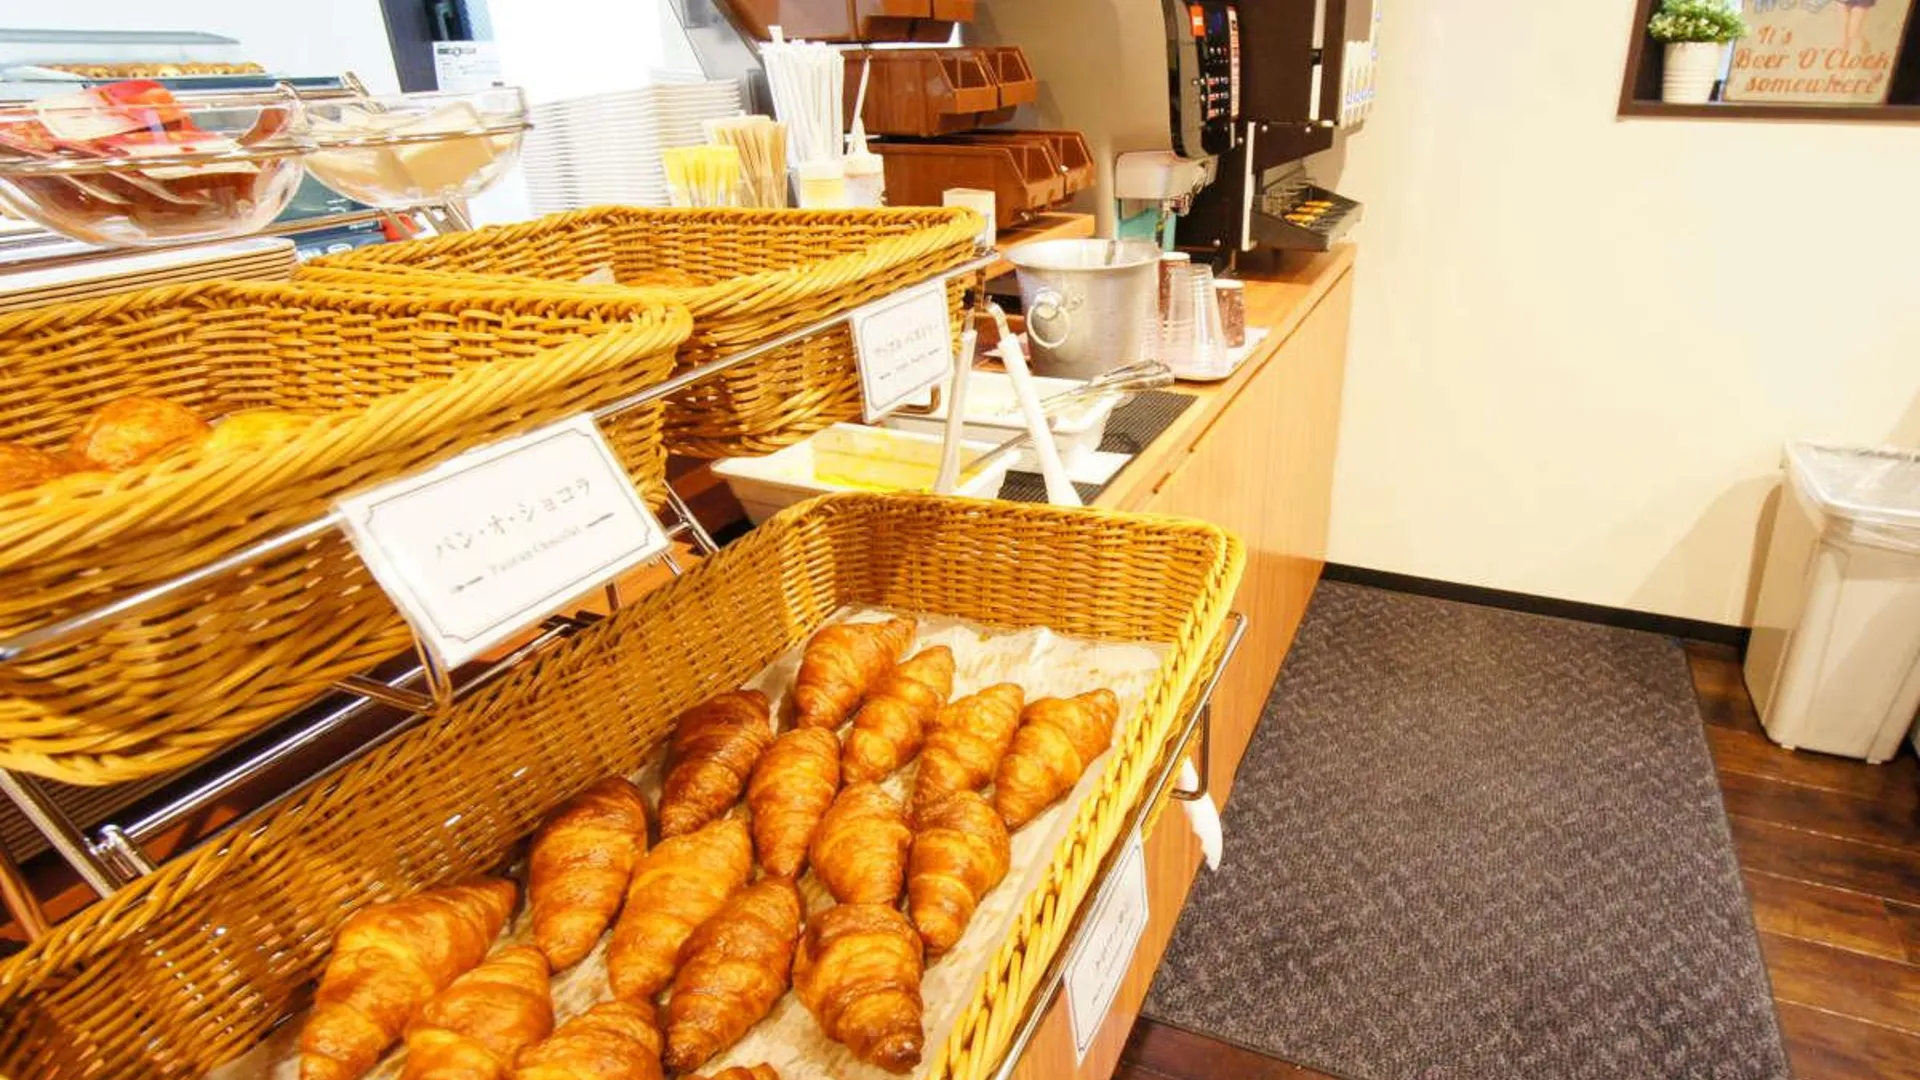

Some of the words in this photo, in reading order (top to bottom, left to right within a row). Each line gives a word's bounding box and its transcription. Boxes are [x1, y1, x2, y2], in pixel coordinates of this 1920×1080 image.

[1757, 24, 1793, 45] It's
[1736, 49, 1788, 69] Beer
[1748, 72, 1882, 93] somewhere
